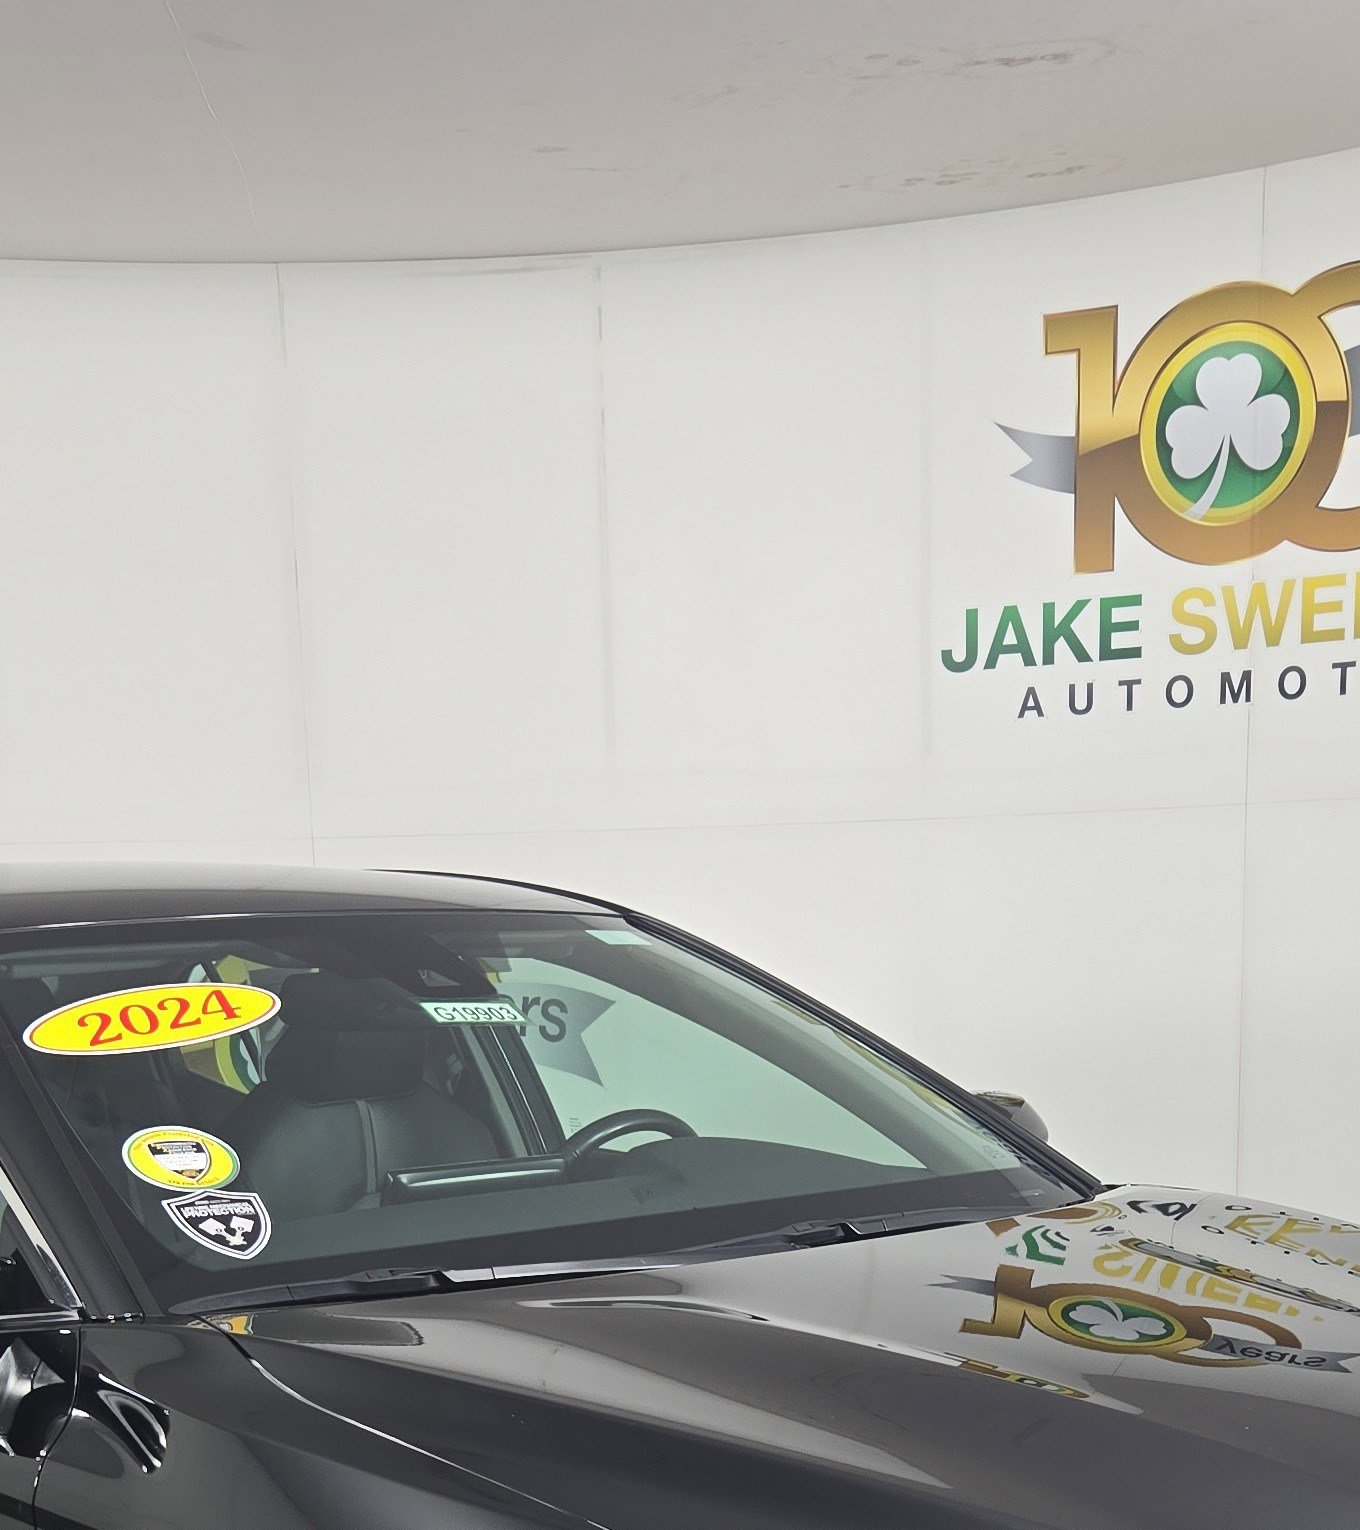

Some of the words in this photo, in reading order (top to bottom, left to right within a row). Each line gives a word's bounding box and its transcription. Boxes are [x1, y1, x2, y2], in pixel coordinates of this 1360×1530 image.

[941, 593, 1142, 673] JAKE
[77, 989, 242, 1047] 2024
[433, 1005, 518, 1021] G19903
